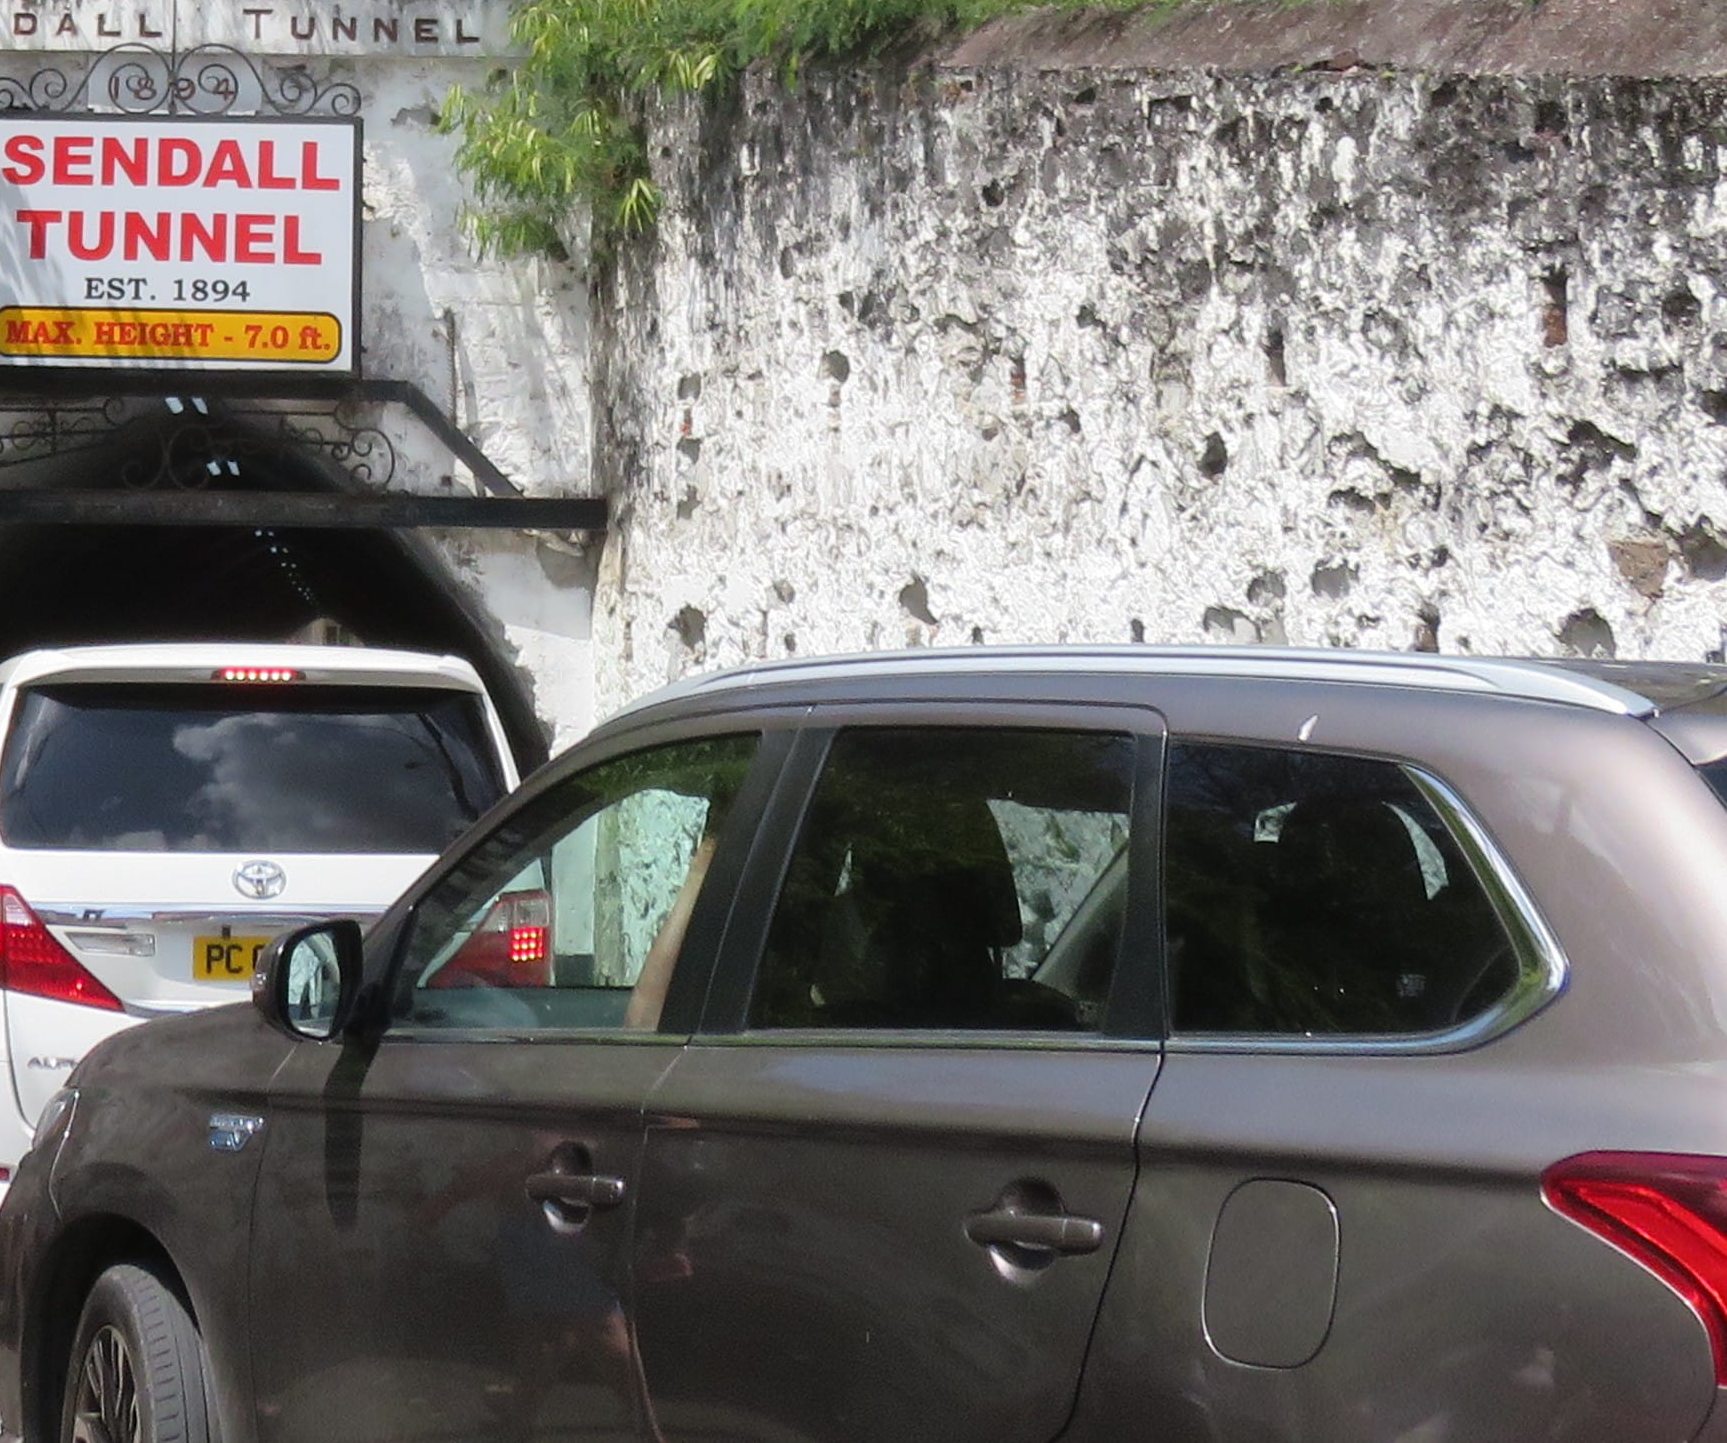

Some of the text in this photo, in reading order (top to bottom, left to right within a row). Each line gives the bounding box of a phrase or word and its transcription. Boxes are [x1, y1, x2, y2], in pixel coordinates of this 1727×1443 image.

[243, 7, 482, 45] TUNNEL
[2, 134, 341, 192] SENDALL
[15, 209, 323, 266] TUNNEL
[84, 277, 251, 303] EST. 1894
[5, 319, 83, 347] MAX.
[94, 321, 214, 350] HEIGHT
[241, 324, 290, 351] 7.0
[298, 324, 331, 352] ft.
[205, 943, 243, 975] PC
